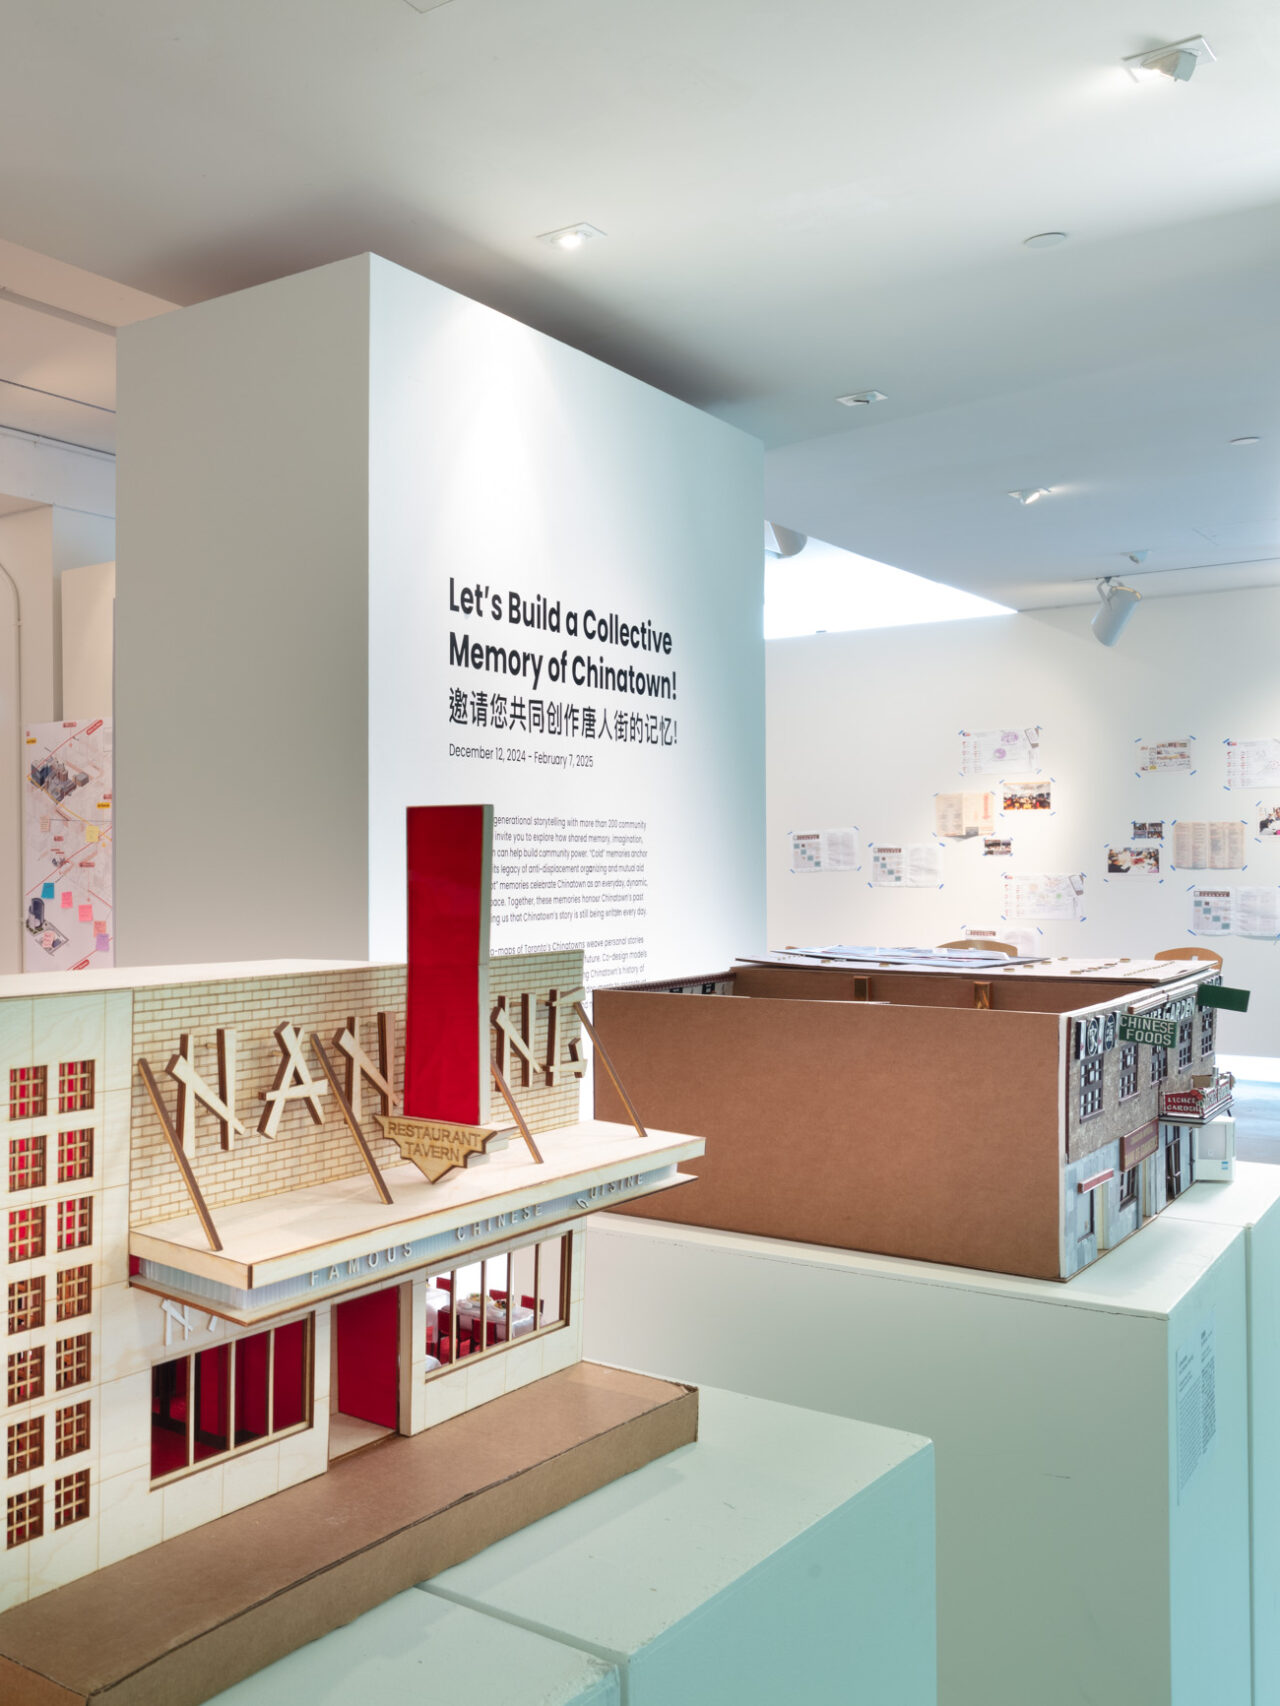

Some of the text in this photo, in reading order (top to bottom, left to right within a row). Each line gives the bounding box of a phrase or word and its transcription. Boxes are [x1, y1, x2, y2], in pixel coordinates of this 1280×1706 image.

[449, 577, 673, 655] Let's Build a Collective
[449, 631, 677, 700] Memory of Chinatown!
[449, 743, 494, 760] December
[495, 747, 505, 763] 12,
[506, 748, 526, 762] 2024
[534, 751, 568, 769] February
[568, 753, 575, 768] 7,
[576, 754, 594, 768] 2025
[580, 819, 594, 828] more
[513, 832, 525, 843] you
[526, 831, 532, 842] to
[533, 831, 554, 845] explore
[555, 832, 567, 842] how
[568, 833, 587, 843] shared
[497, 849, 508, 858] can
[509, 847, 522, 860] help
[523, 847, 538, 858] build
[501, 864, 520, 877] legacy
[522, 864, 528, 873] of
[608, 864, 618, 872] and
[500, 879, 529, 890] memories
[530, 879, 556, 889] celebrate
[558, 878, 586, 889] Chinatown
[587, 880, 593, 888] as
[594, 880, 601, 888] an
[536, 896, 552, 905] these
[553, 894, 581, 905] memories
[633, 892, 644, 904] past
[510, 912, 523, 923] that
[559, 909, 573, 922] story
[590, 908, 605, 920] being
[1120, 1014, 1175, 1034] CHINESE
[1126, 1028, 1172, 1046] FOODS
[388, 1121, 481, 1147] RESTAURANT
[405, 1141, 460, 1162] TAVERN
[310, 1243, 412, 1286] FAMOUS
[456, 1203, 545, 1241] CHINESE
